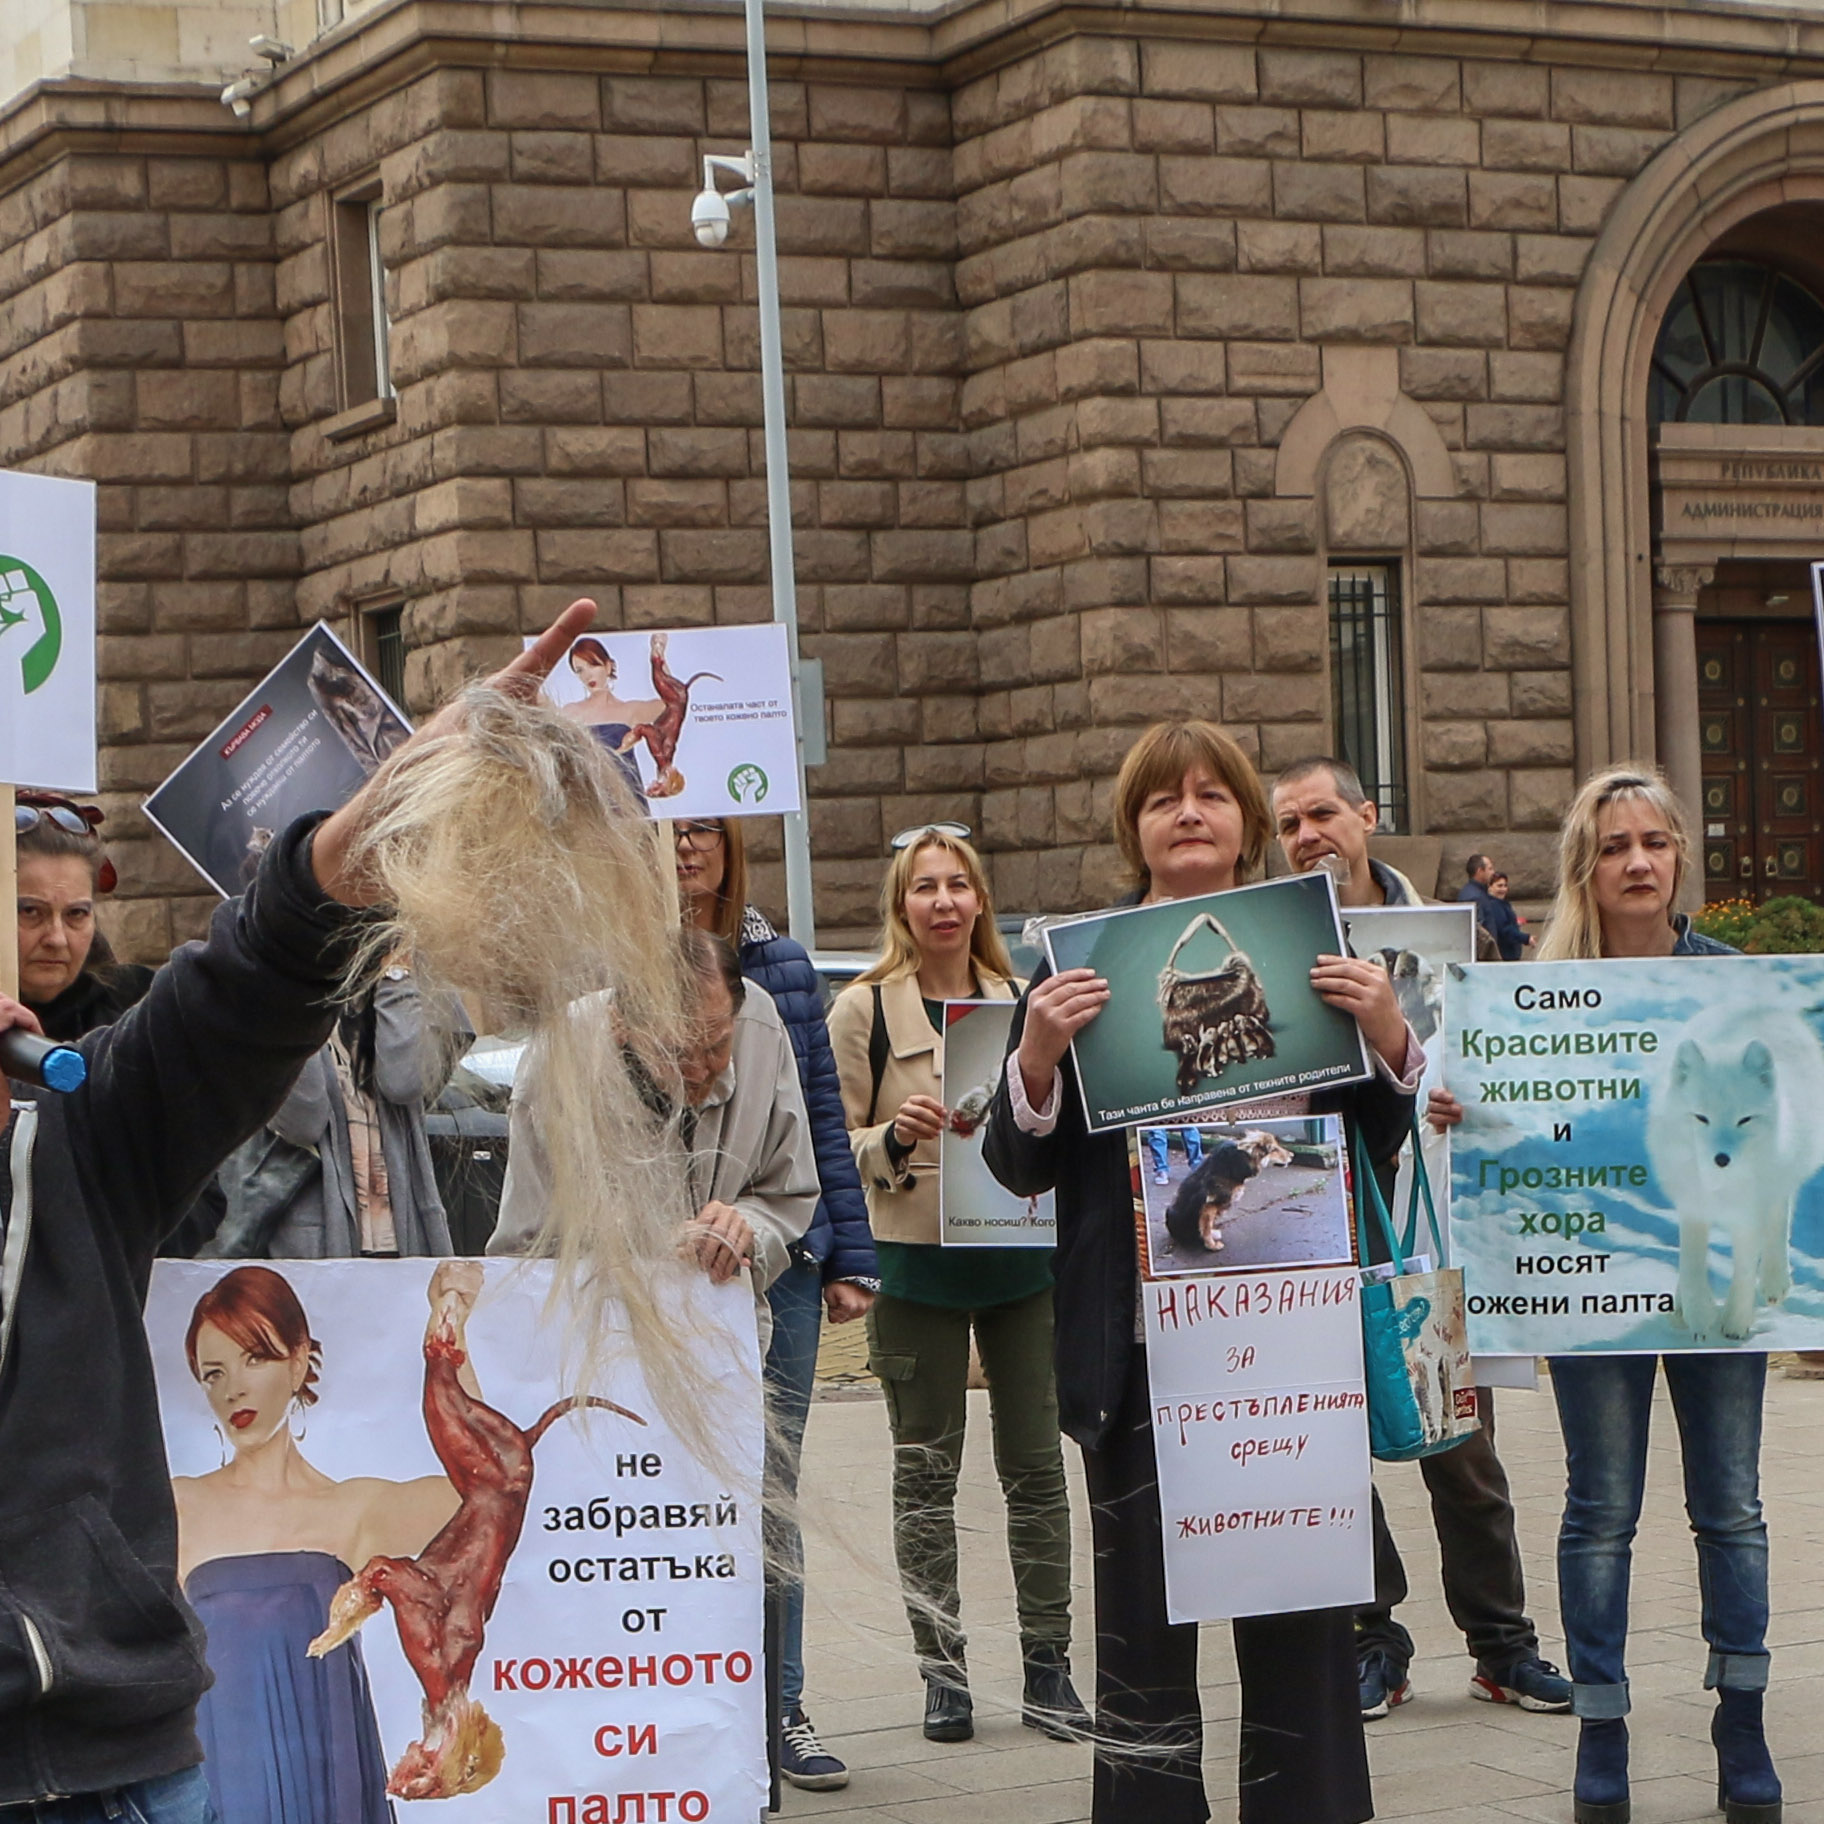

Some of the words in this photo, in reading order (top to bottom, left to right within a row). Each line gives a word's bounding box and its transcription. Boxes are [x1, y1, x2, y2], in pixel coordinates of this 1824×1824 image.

[1721, 463, 1822, 481] РЕПУБЛИКА
[1681, 501, 1823, 521] АДМИНИСТРАЦИЯ
[690, 701, 744, 712] Останалата
[745, 700, 766, 709] част
[768, 699, 778, 707] от
[760, 710, 787, 719] палто
[265, 755, 275, 768] от
[285, 765, 295, 776] от
[1514, 984, 1602, 1010] Само
[1461, 1028, 1658, 1064] Красивите
[1098, 1109, 1126, 1122] Тази
[1126, 1102, 1159, 1117] чанта
[1161, 1096, 1175, 1109] бе
[1177, 1087, 1237, 1106] направена
[1238, 1083, 1251, 1094] от
[1254, 1075, 1296, 1091] техните
[1298, 1063, 1352, 1085] родители
[1479, 1077, 1641, 1103] животни
[1553, 1123, 1572, 1142] и
[1479, 1158, 1648, 1196] Грозните
[948, 1216, 982, 1227] Какво
[984, 1215, 1027, 1227] носиш?
[1030, 1216, 1056, 1228] Кого
[1518, 1211, 1606, 1241] хора
[1516, 1254, 1611, 1275] носят
[1156, 1276, 1357, 1332] НАКАЗАНИЯ
[1467, 1295, 1570, 1315] ожени
[1581, 1292, 1675, 1314] палта
[1226, 1345, 1256, 1373] ЗА
[1230, 1433, 1309, 1468] СРЕЩУ
[615, 1452, 663, 1478] не
[542, 1494, 738, 1538] забравяй
[547, 1553, 737, 1584] остатъка
[621, 1608, 669, 1633] от
[493, 1650, 753, 1692] коженото
[593, 1724, 658, 1757] си
